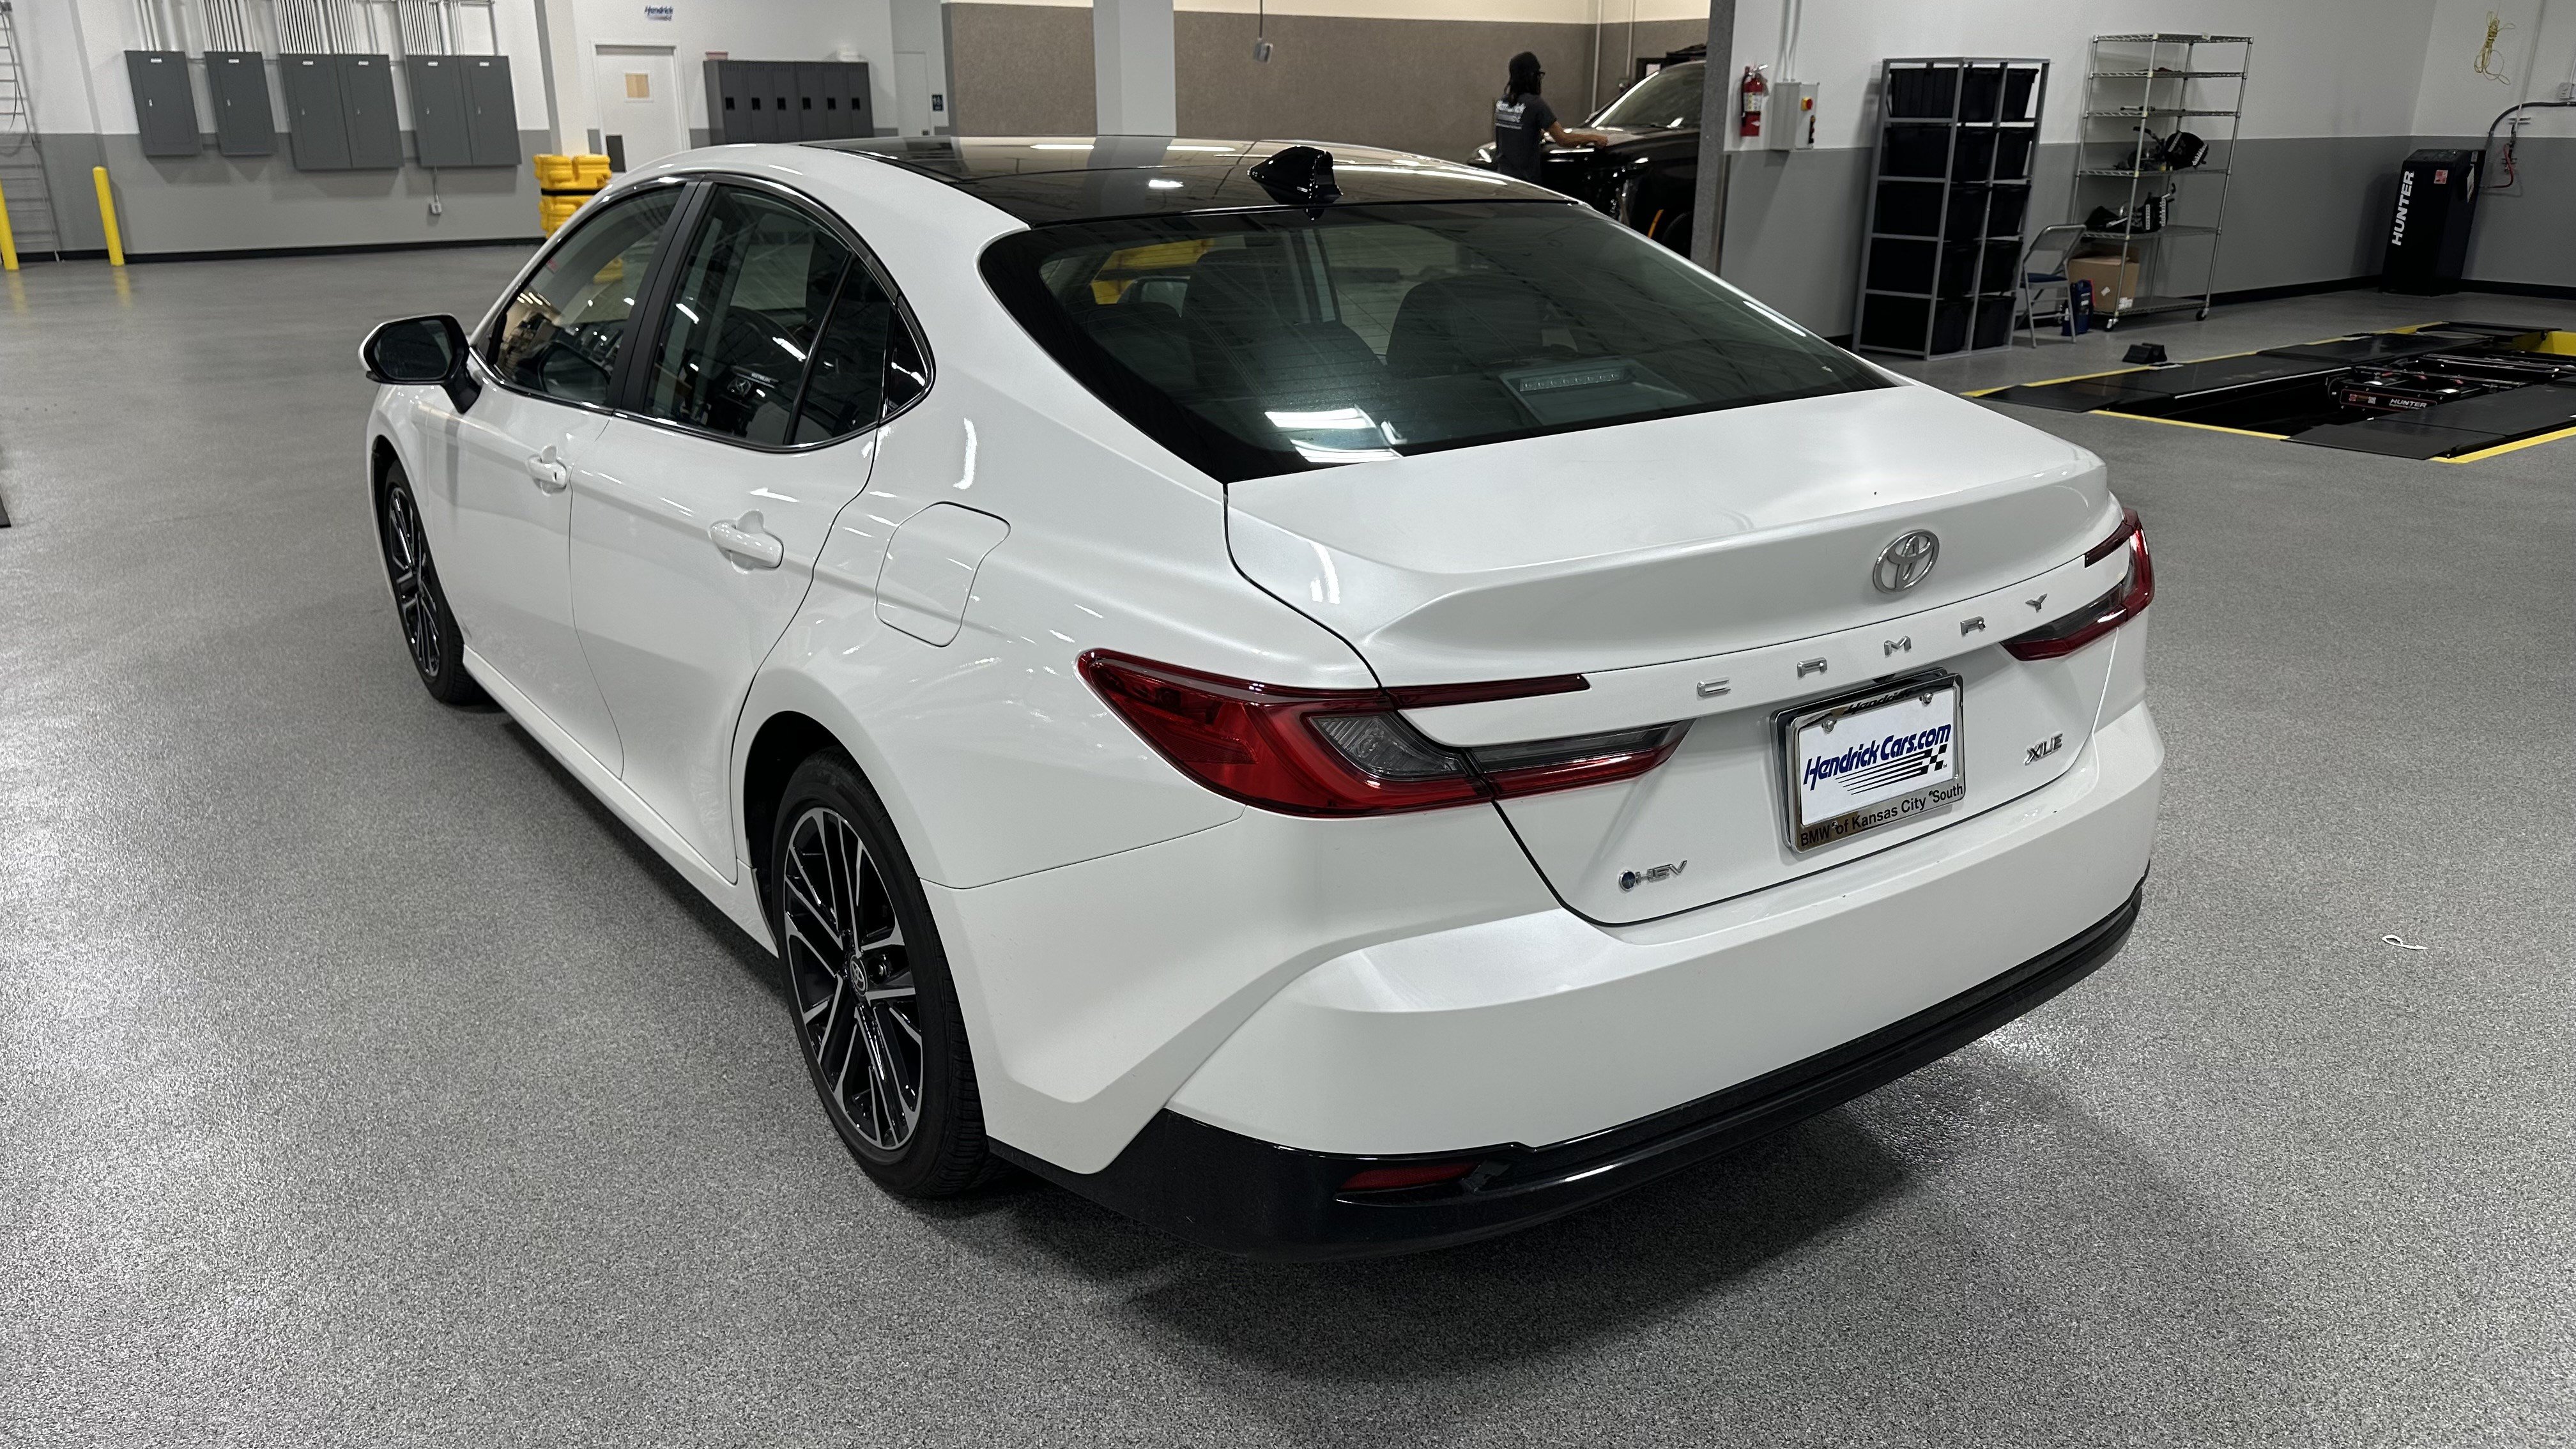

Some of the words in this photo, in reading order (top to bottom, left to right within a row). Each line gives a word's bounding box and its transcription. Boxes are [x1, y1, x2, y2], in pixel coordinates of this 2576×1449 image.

[2391, 171, 2414, 246] HUNTER
[2389, 399, 2427, 408] HUNTER
[1697, 593, 2048, 698] CAMRY
[2023, 733, 2063, 766] XLE
[1801, 824, 1830, 847] BMW
[1836, 822, 1849, 836] of
[1852, 805, 1898, 831] Kansas
[1901, 797, 1927, 812] City
[1932, 783, 1964, 803] South
[1635, 859, 1688, 885] HEV
